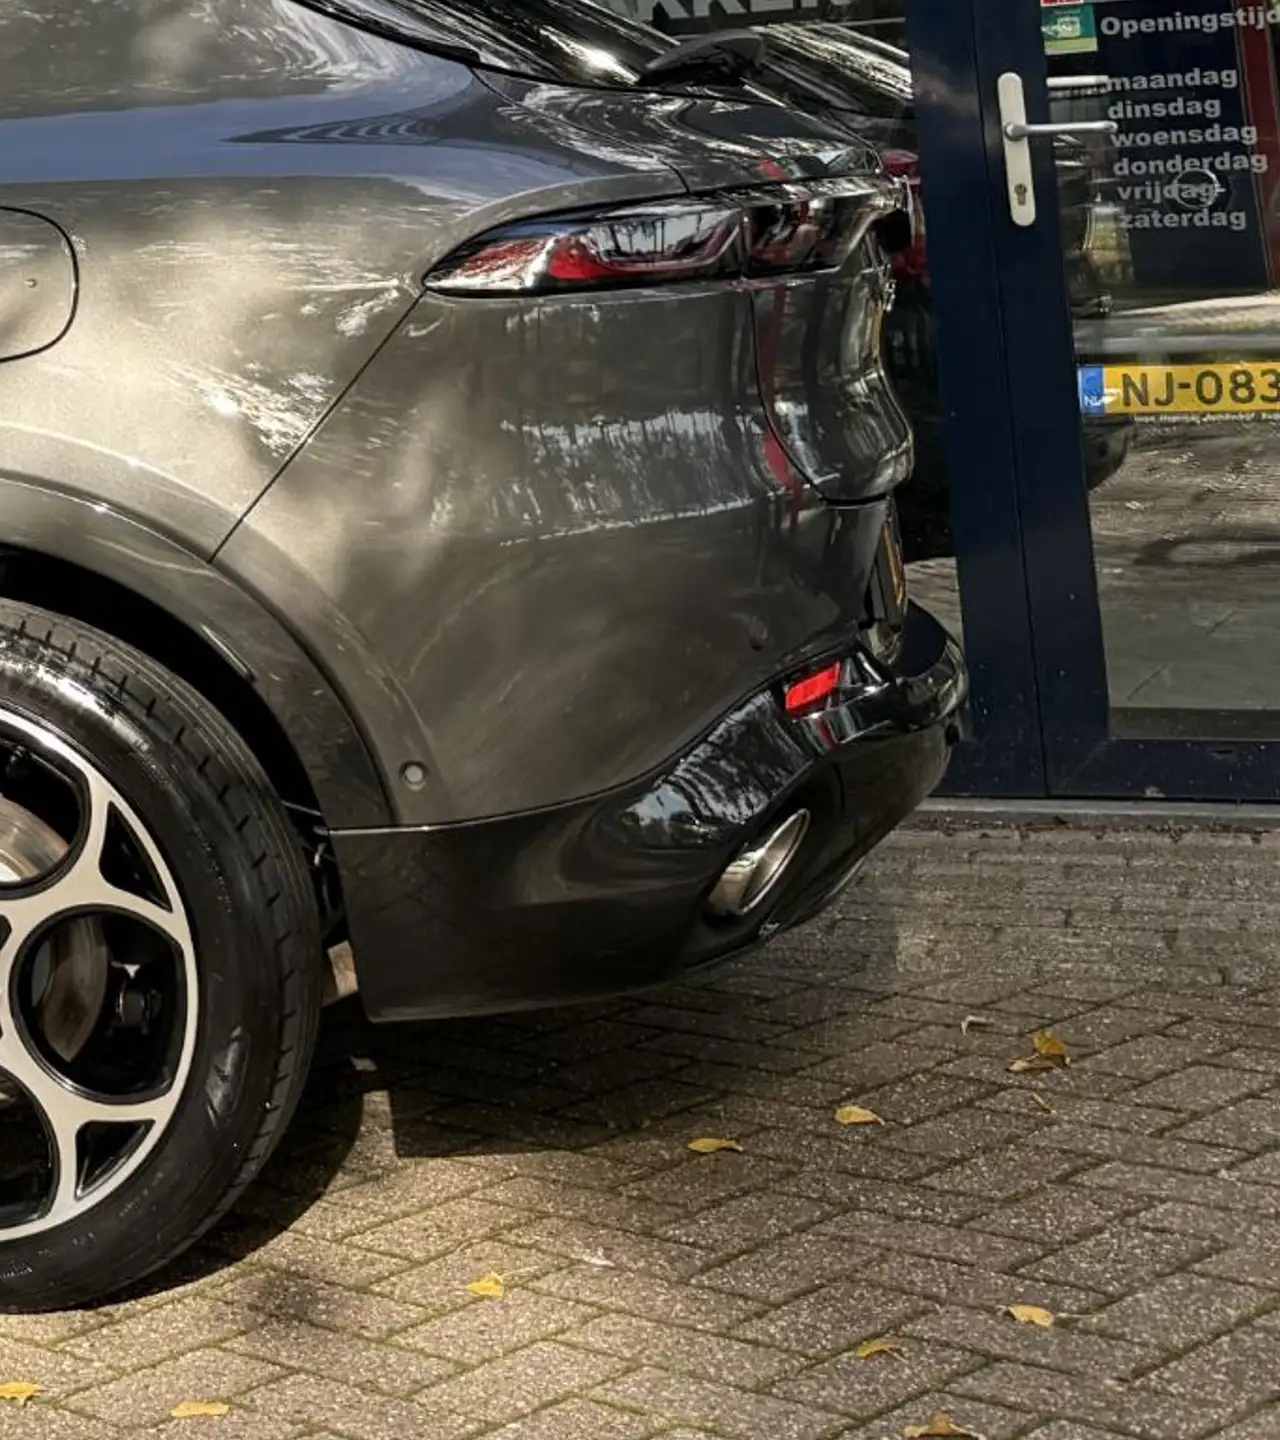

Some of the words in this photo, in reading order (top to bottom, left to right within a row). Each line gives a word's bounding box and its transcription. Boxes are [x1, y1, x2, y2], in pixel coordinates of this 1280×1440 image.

[1107, 67, 1238, 91] maandag
[1107, 97, 1221, 119] dinsdag
[1109, 123, 1257, 148] woensdag
[1112, 151, 1268, 176] donderdag
[1116, 181, 1216, 203] vrijdag
[1118, 209, 1247, 230] zaterdag
